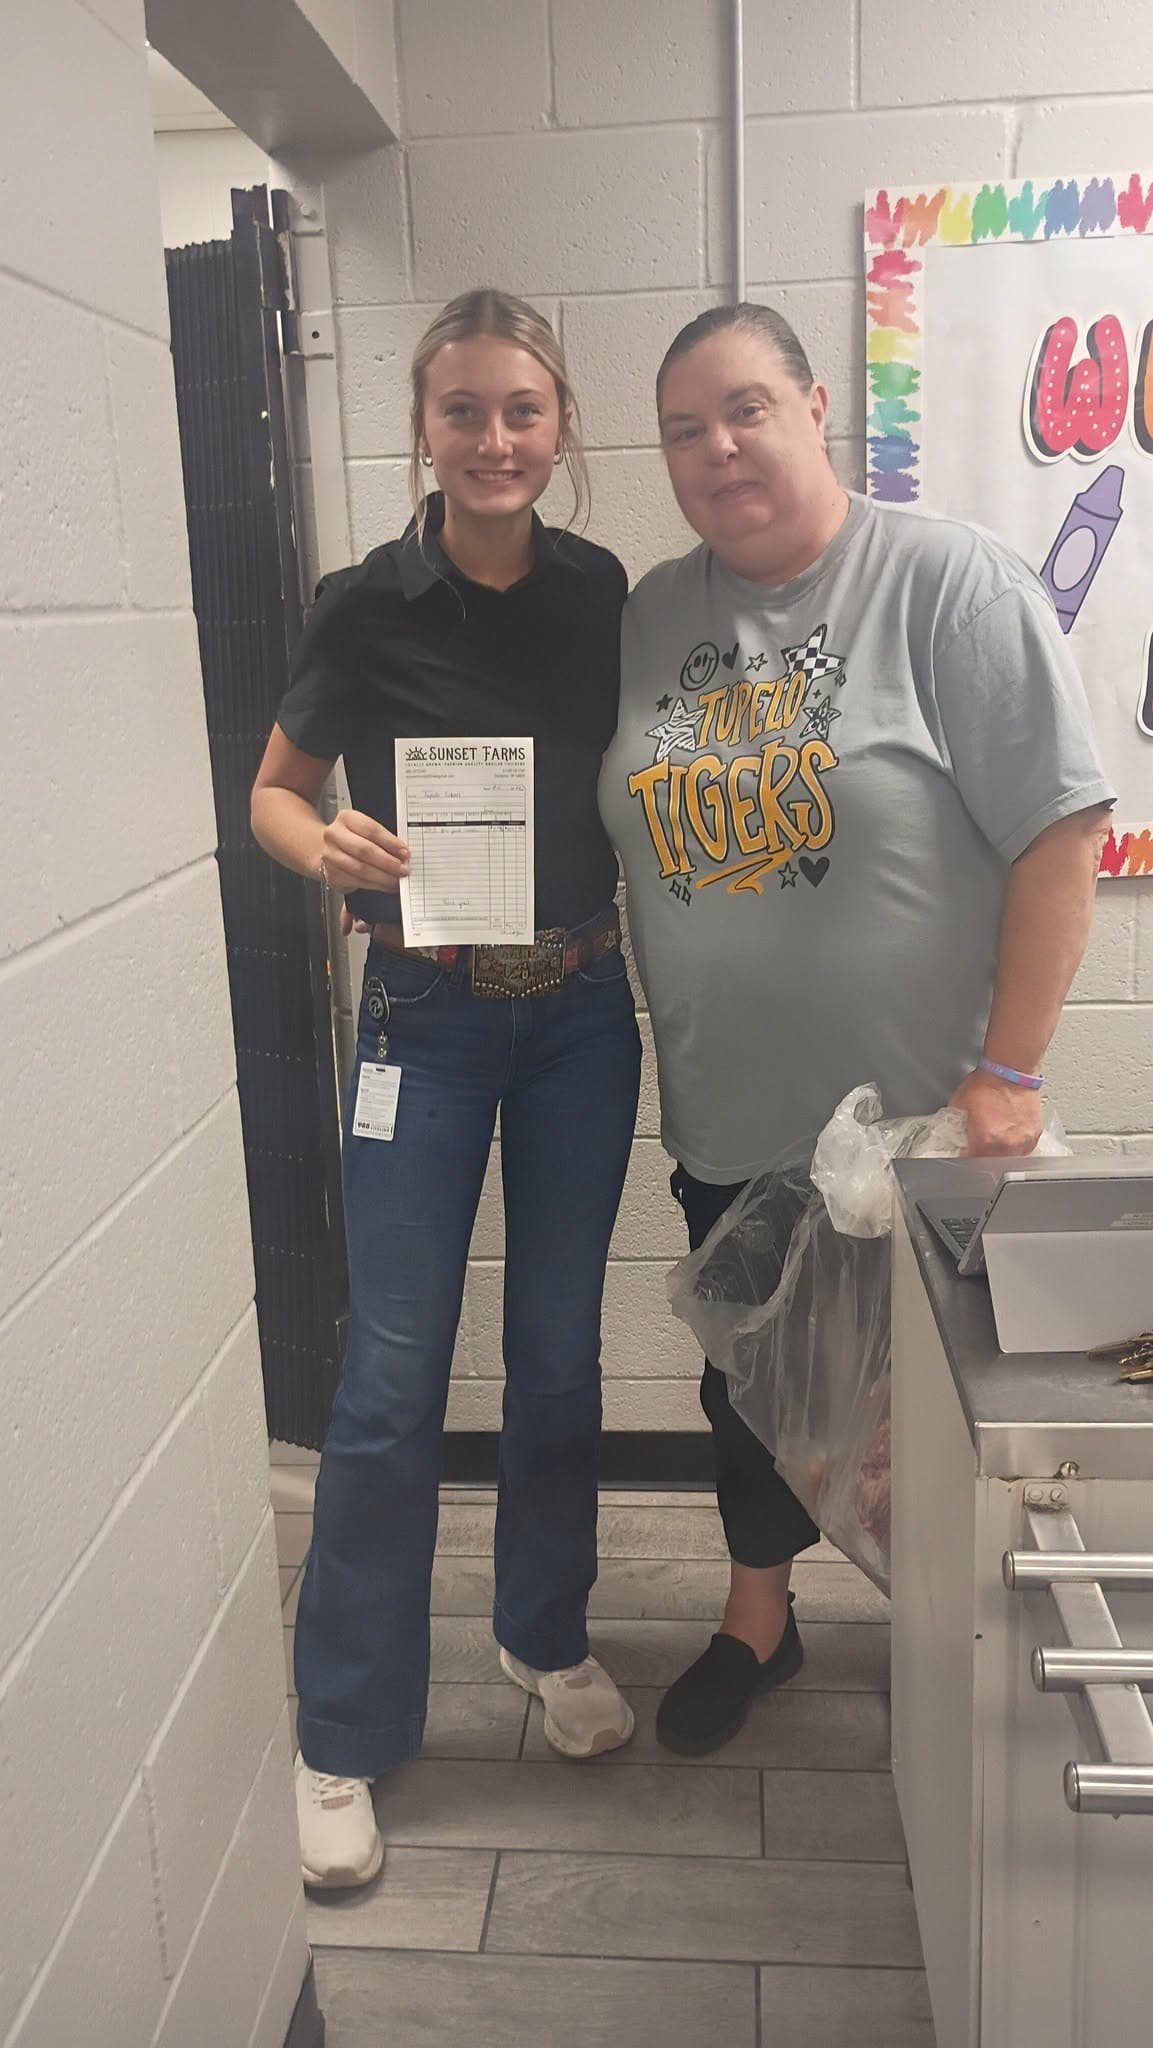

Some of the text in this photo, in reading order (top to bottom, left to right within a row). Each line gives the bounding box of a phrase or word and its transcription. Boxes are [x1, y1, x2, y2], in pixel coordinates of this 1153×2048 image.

[1028, 313, 1153, 459] W
[429, 746, 525, 761] SUNSET FARMS
[696, 671, 808, 748] TUPELO
[628, 738, 839, 878] TIGERS
